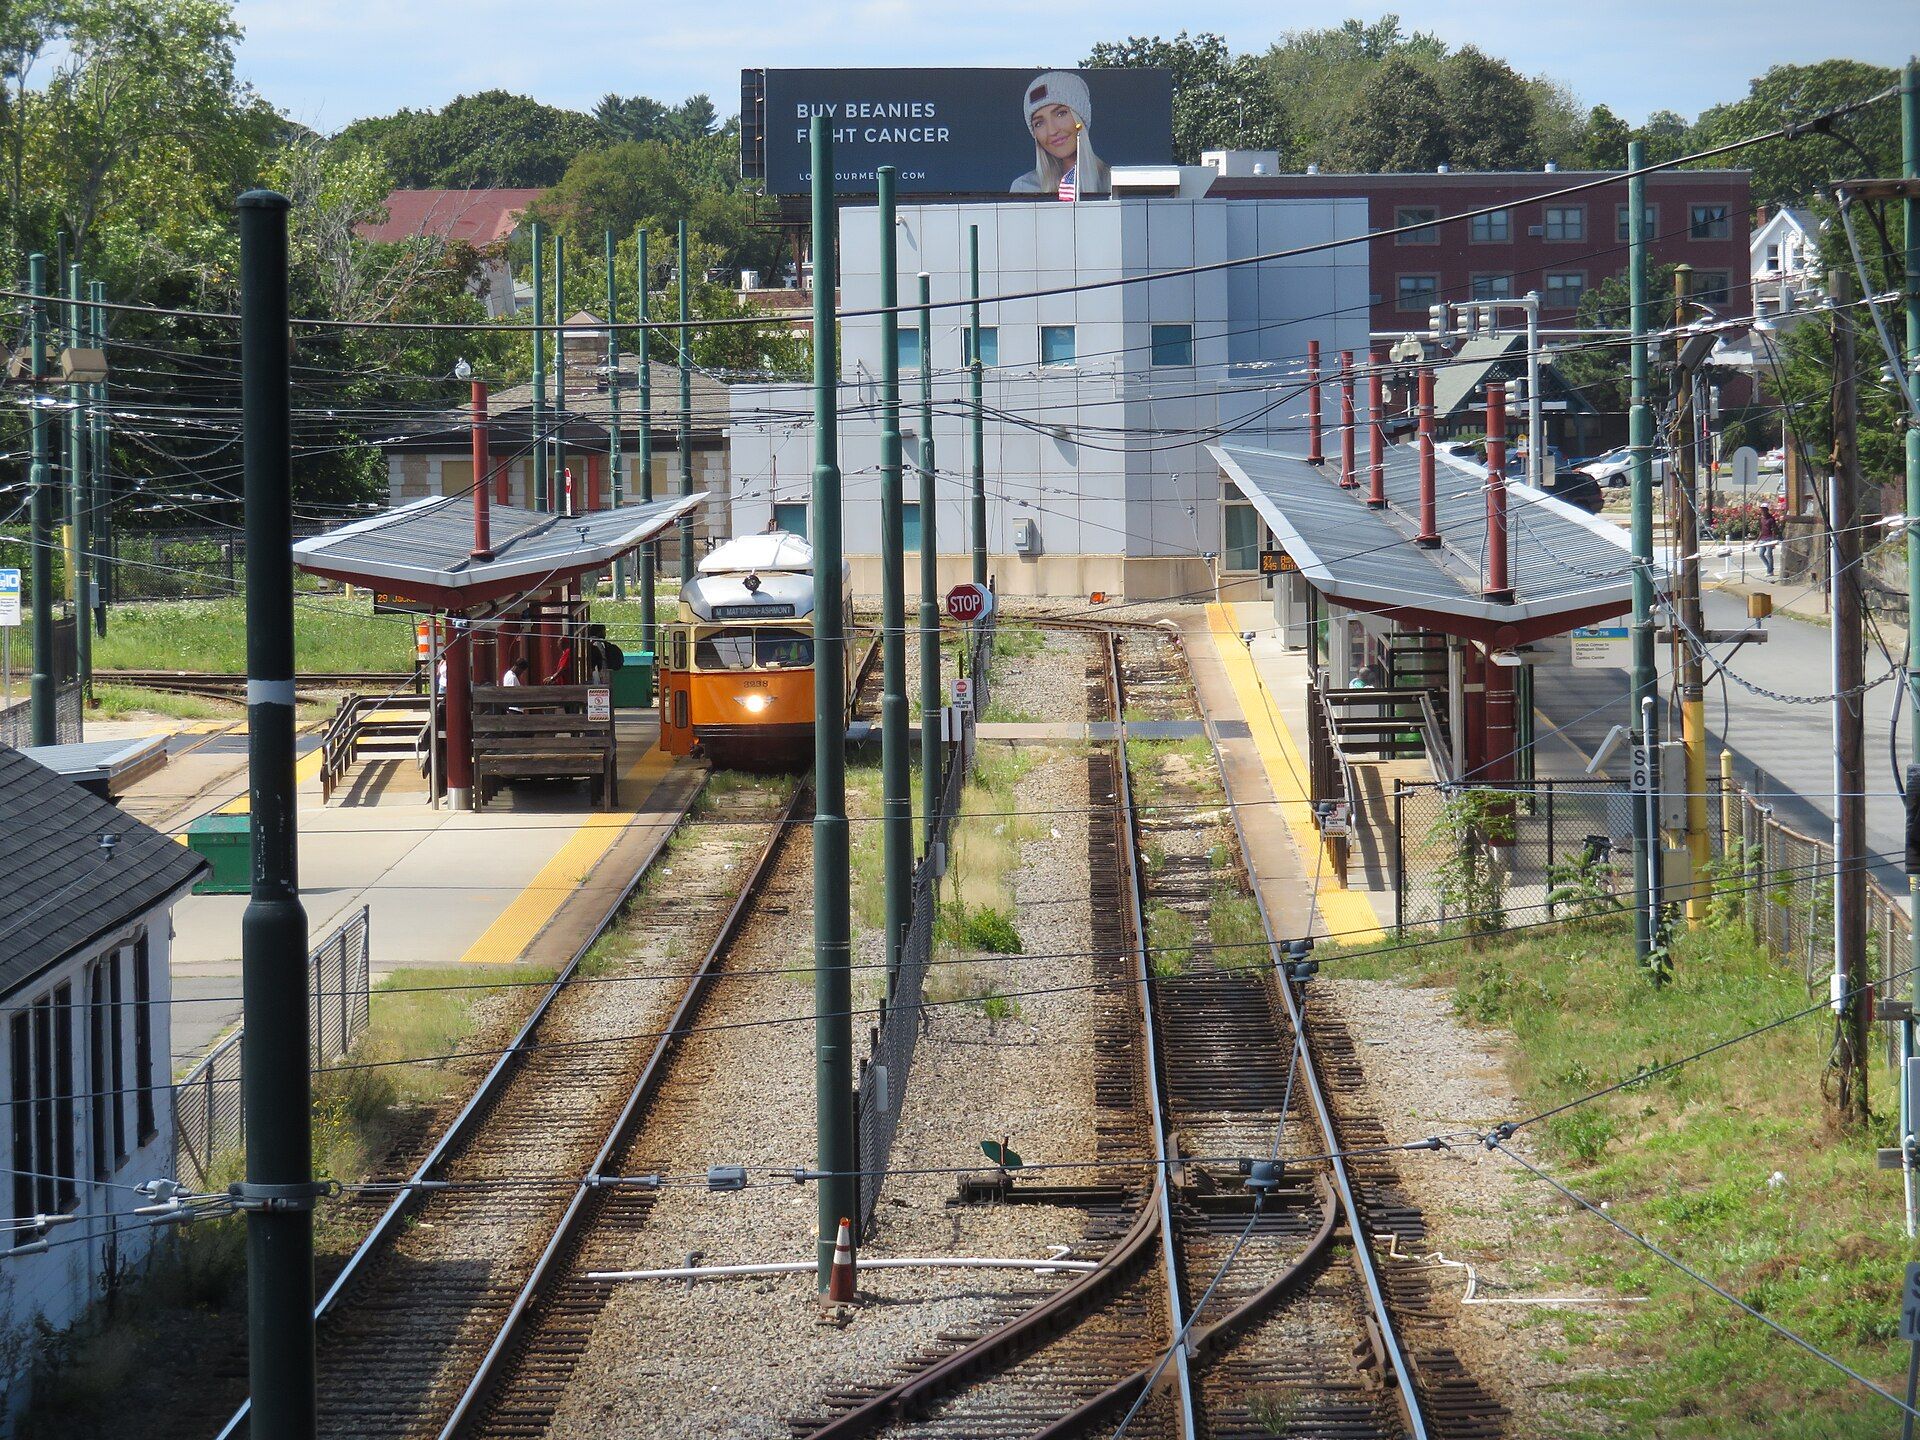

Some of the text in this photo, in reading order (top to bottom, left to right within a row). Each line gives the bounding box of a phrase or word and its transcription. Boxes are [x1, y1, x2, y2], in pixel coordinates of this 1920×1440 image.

[797, 102, 936, 119] BUY BEANIES
[797, 127, 950, 144] FIHT CANCER
[377, 594, 388, 603] 29
[950, 594, 981, 613] STOP
[1634, 749, 1646, 766] S
[1633, 769, 1646, 787] 6
